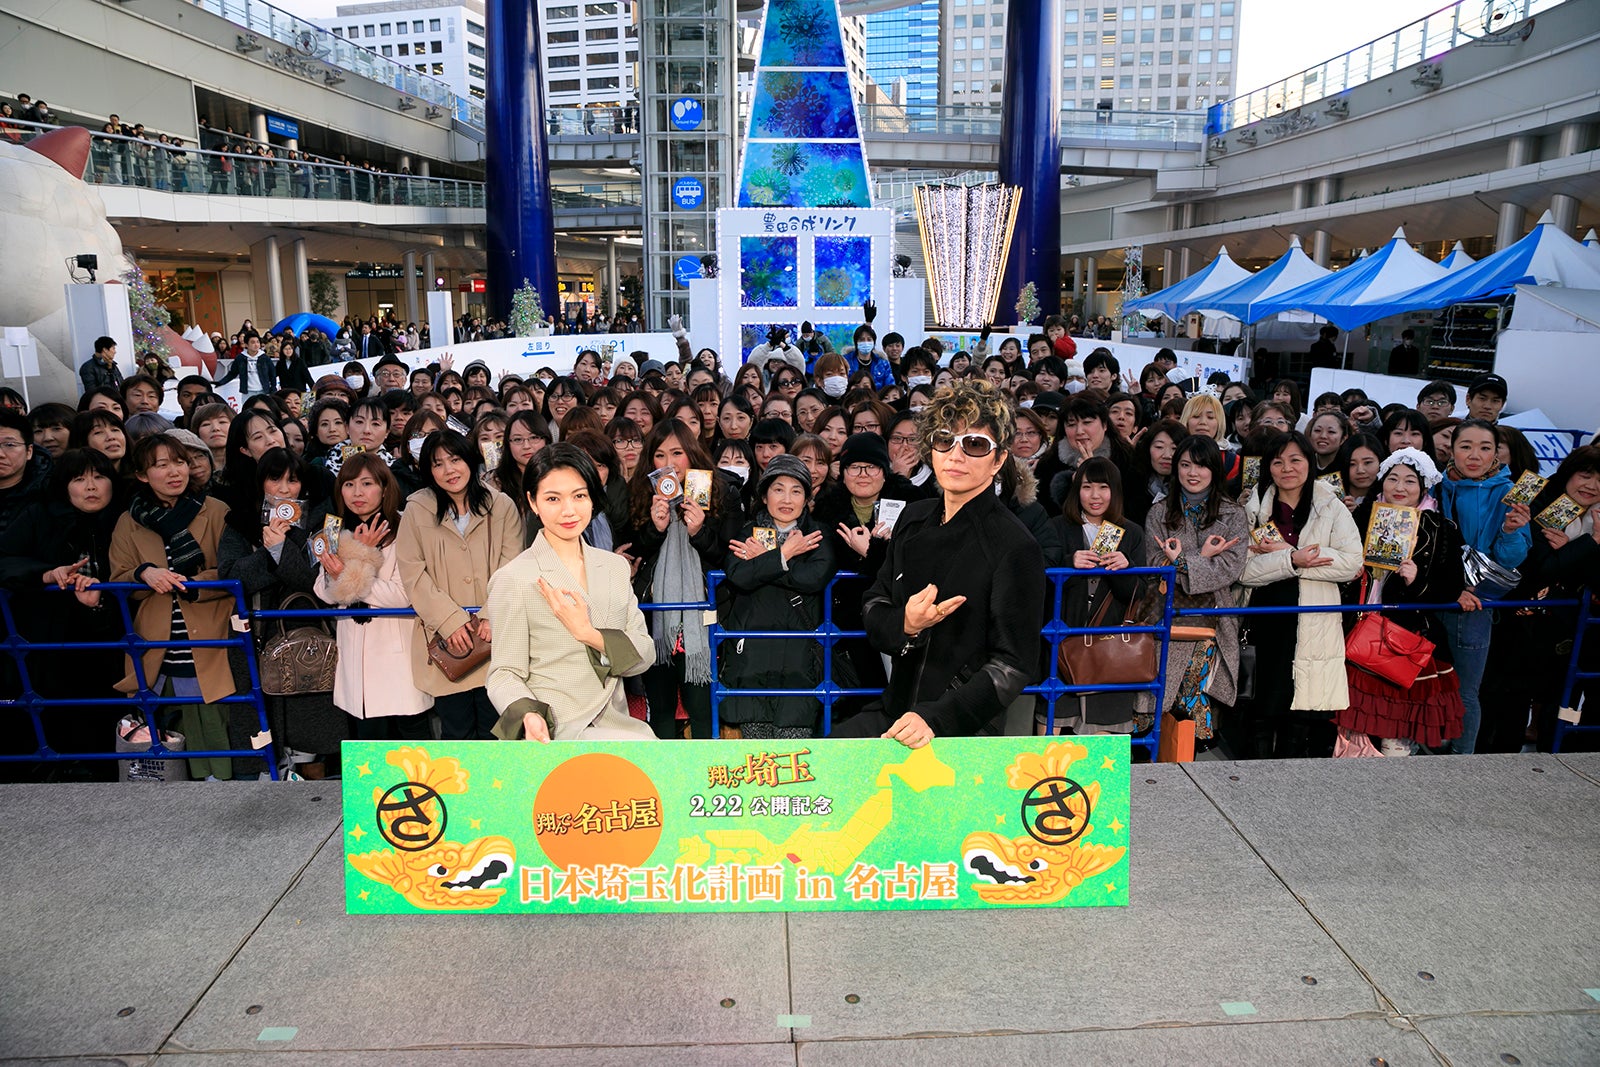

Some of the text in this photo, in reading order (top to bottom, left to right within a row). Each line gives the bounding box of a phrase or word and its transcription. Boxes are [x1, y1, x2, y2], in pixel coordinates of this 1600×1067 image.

[763, 212, 856, 233] 豊田合成リンク
[527, 341, 551, 351] 左回り
[707, 748, 814, 788] 翔んで埼玉
[378, 787, 438, 843] さ
[536, 797, 661, 835] 翔んで名古屋
[690, 795, 833, 817] 2.22 公開記念
[1023, 781, 1082, 838] さ
[520, 862, 959, 903] 日本埼玉化計画 in 名古屋
